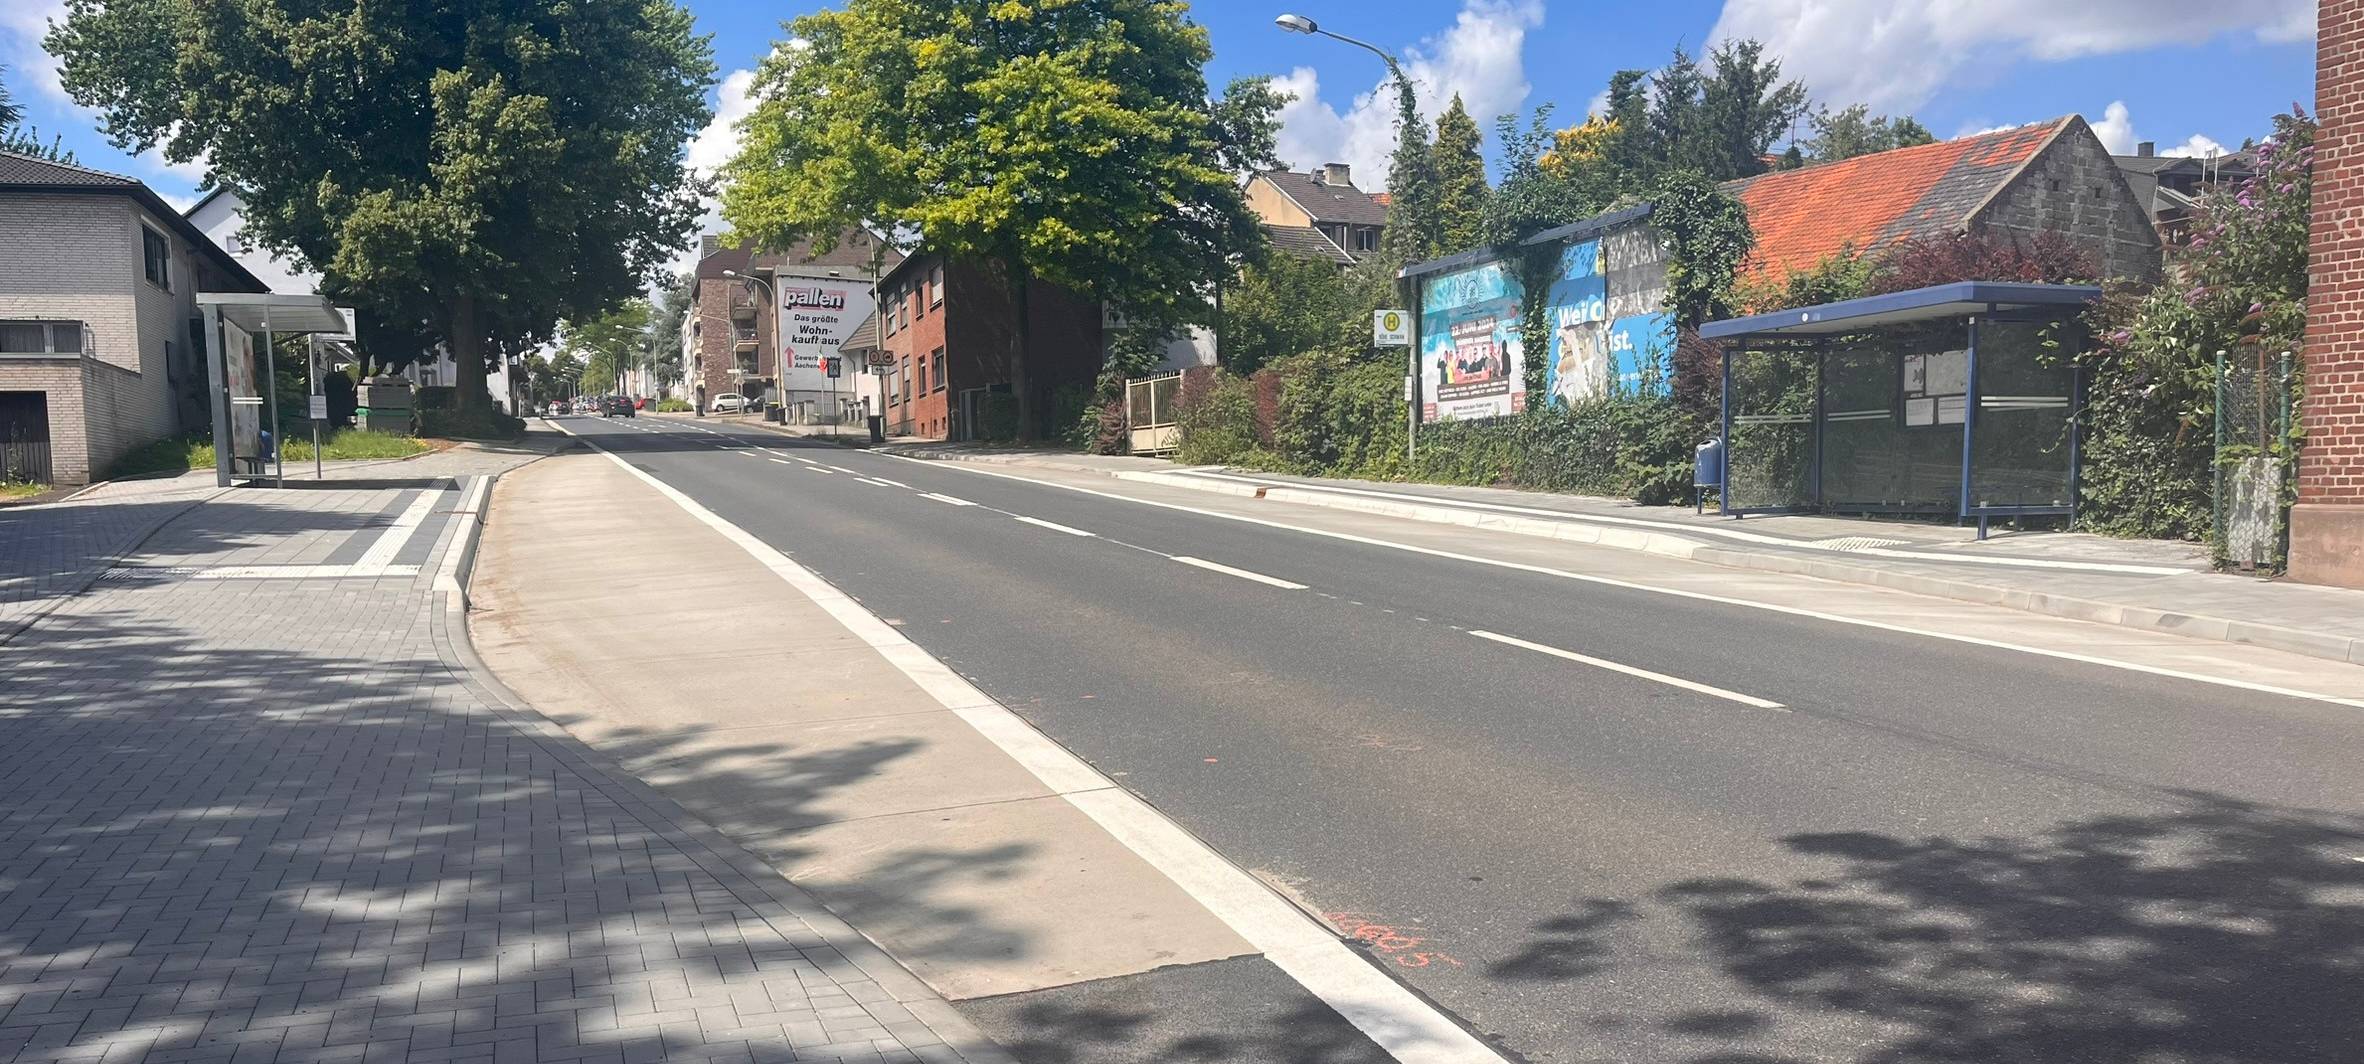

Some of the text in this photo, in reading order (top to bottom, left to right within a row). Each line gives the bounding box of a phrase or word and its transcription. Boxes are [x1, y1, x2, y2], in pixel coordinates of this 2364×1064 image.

[784, 287, 844, 310] pallen
[812, 315, 839, 323] größte
[1558, 300, 1588, 328] Weil
[799, 325, 833, 335] Wohn-
